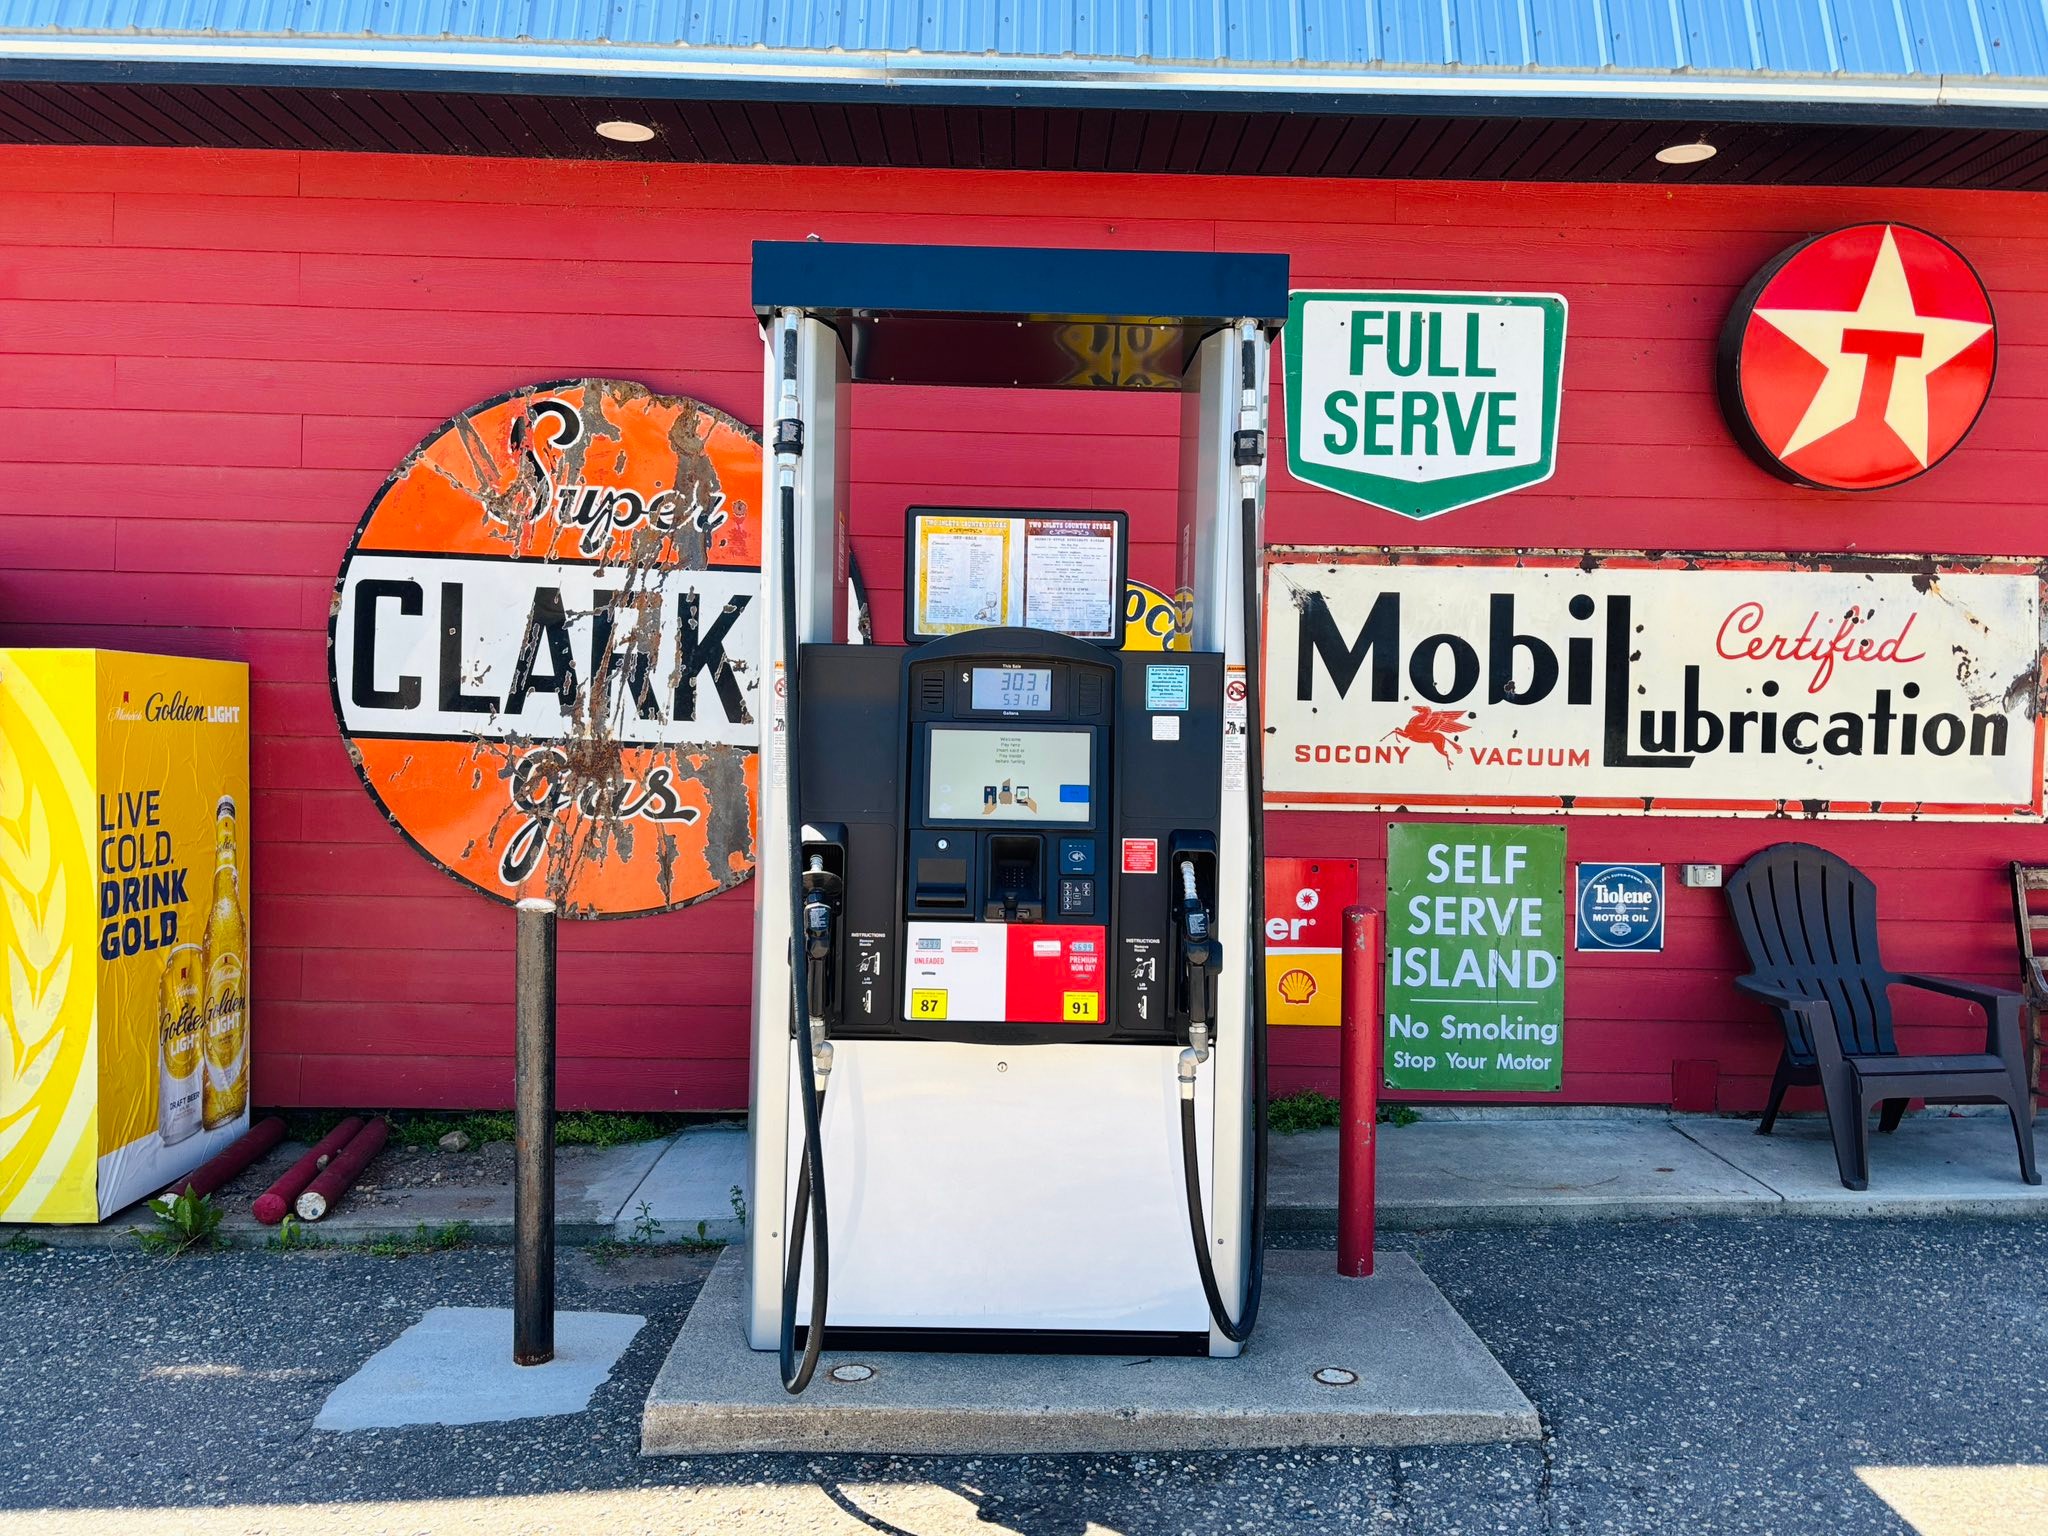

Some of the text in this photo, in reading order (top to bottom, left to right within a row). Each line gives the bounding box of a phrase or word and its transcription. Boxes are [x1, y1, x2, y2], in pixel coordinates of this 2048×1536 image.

[1350, 310, 1496, 377] FULL
[1324, 390, 1516, 456] SERVE
[489, 397, 730, 556] Super
[351, 579, 755, 724] CLARK
[1716, 602, 1926, 694] Certified
[962, 673, 969, 683] $
[145, 691, 208, 722] Golden
[207, 705, 240, 723] LIGHT
[1295, 745, 1589, 766] SOCONY VACUUM
[100, 790, 160, 831] LIVE
[101, 831, 174, 874] COLD.
[1426, 844, 1527, 884] SELF
[101, 868, 189, 919] DRINK
[1593, 883, 1652, 903] Tiolene
[1408, 895, 1542, 936] SERVE
[1593, 914, 1648, 922] MOTOR OIL
[101, 911, 179, 960] GOLD.
[914, 957, 944, 965] UNLEADED
[1071, 964, 1083, 972] NON
[1392, 947, 1557, 988] ISLAND
[204, 988, 246, 1023] Golden
[920, 1000, 938, 1012] 87
[1072, 1002, 1089, 1014] 91
[161, 1003, 204, 1046] Golde
[210, 1012, 241, 1037] LIGHT
[1389, 1014, 1558, 1045] No Smoking
[1394, 1051, 1552, 1071] Stop Your Motor
[170, 1091, 200, 1110] DRAFT BEER
